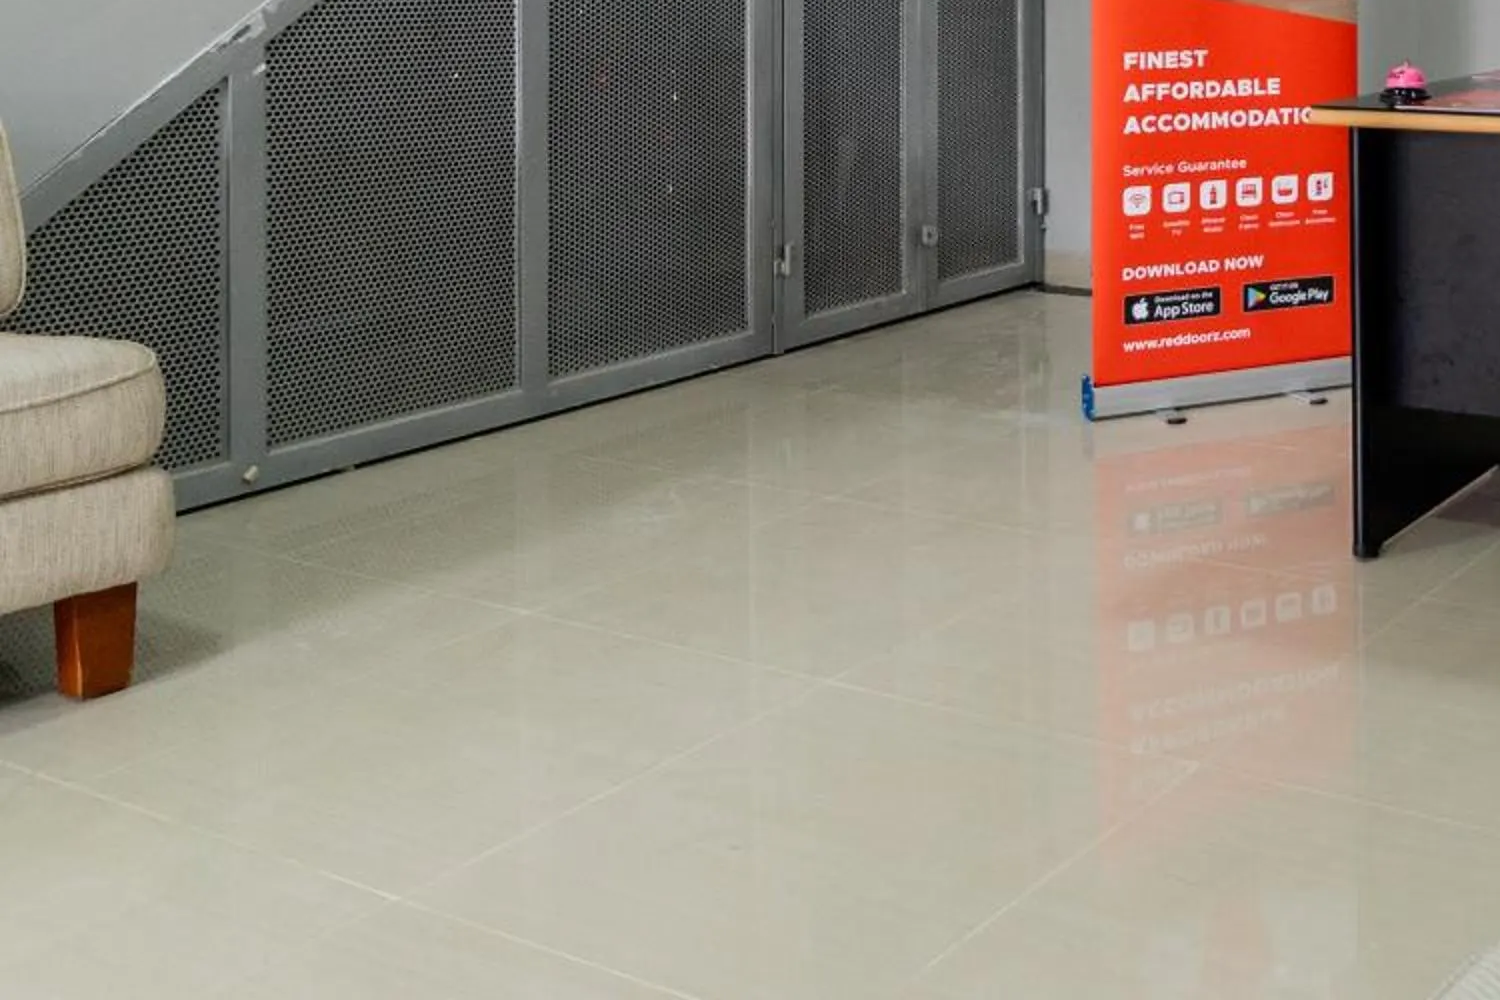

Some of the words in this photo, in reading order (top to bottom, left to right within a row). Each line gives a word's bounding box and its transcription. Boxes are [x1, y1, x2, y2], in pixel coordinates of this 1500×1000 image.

[1122, 49, 1209, 71] FINEST
[1122, 77, 1282, 103] AFFORDABLE
[1122, 162, 1175, 177] Service
[1177, 158, 1248, 173] Guarantee
[1122, 259, 1221, 281] DOWNLOAD
[1223, 254, 1265, 272] NOW
[1269, 290, 1307, 305] Google
[1307, 287, 1329, 303] Play
[1154, 303, 1180, 319] App
[1181, 301, 1215, 316] Store
[1123, 327, 1252, 353] www.reddoorz.com
